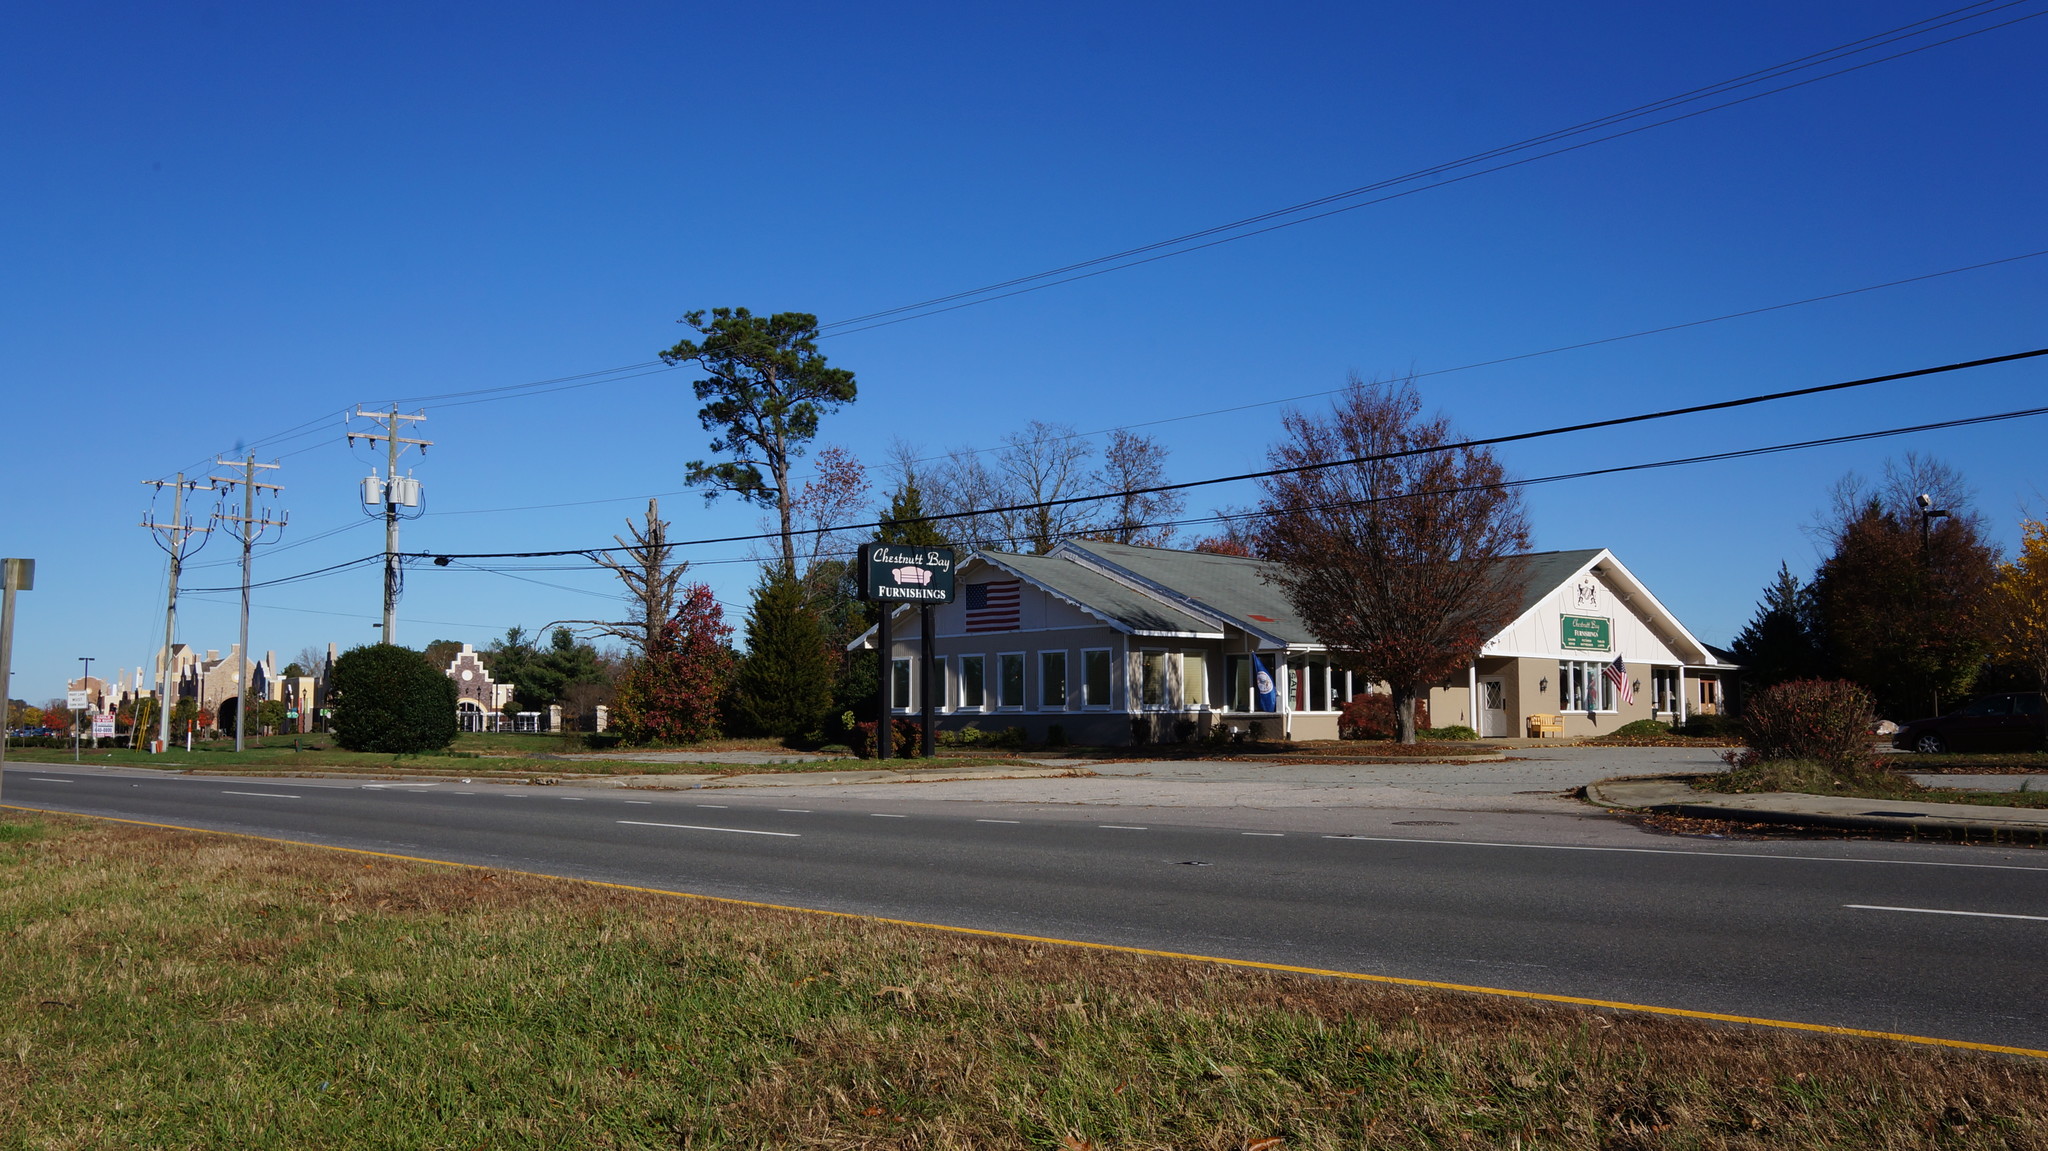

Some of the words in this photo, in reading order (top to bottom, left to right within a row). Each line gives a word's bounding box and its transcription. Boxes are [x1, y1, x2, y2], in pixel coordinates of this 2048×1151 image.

[873, 548, 923, 565] Chestnutt
[926, 551, 950, 572] Bay
[878, 585, 946, 599] FURNISHINGS
